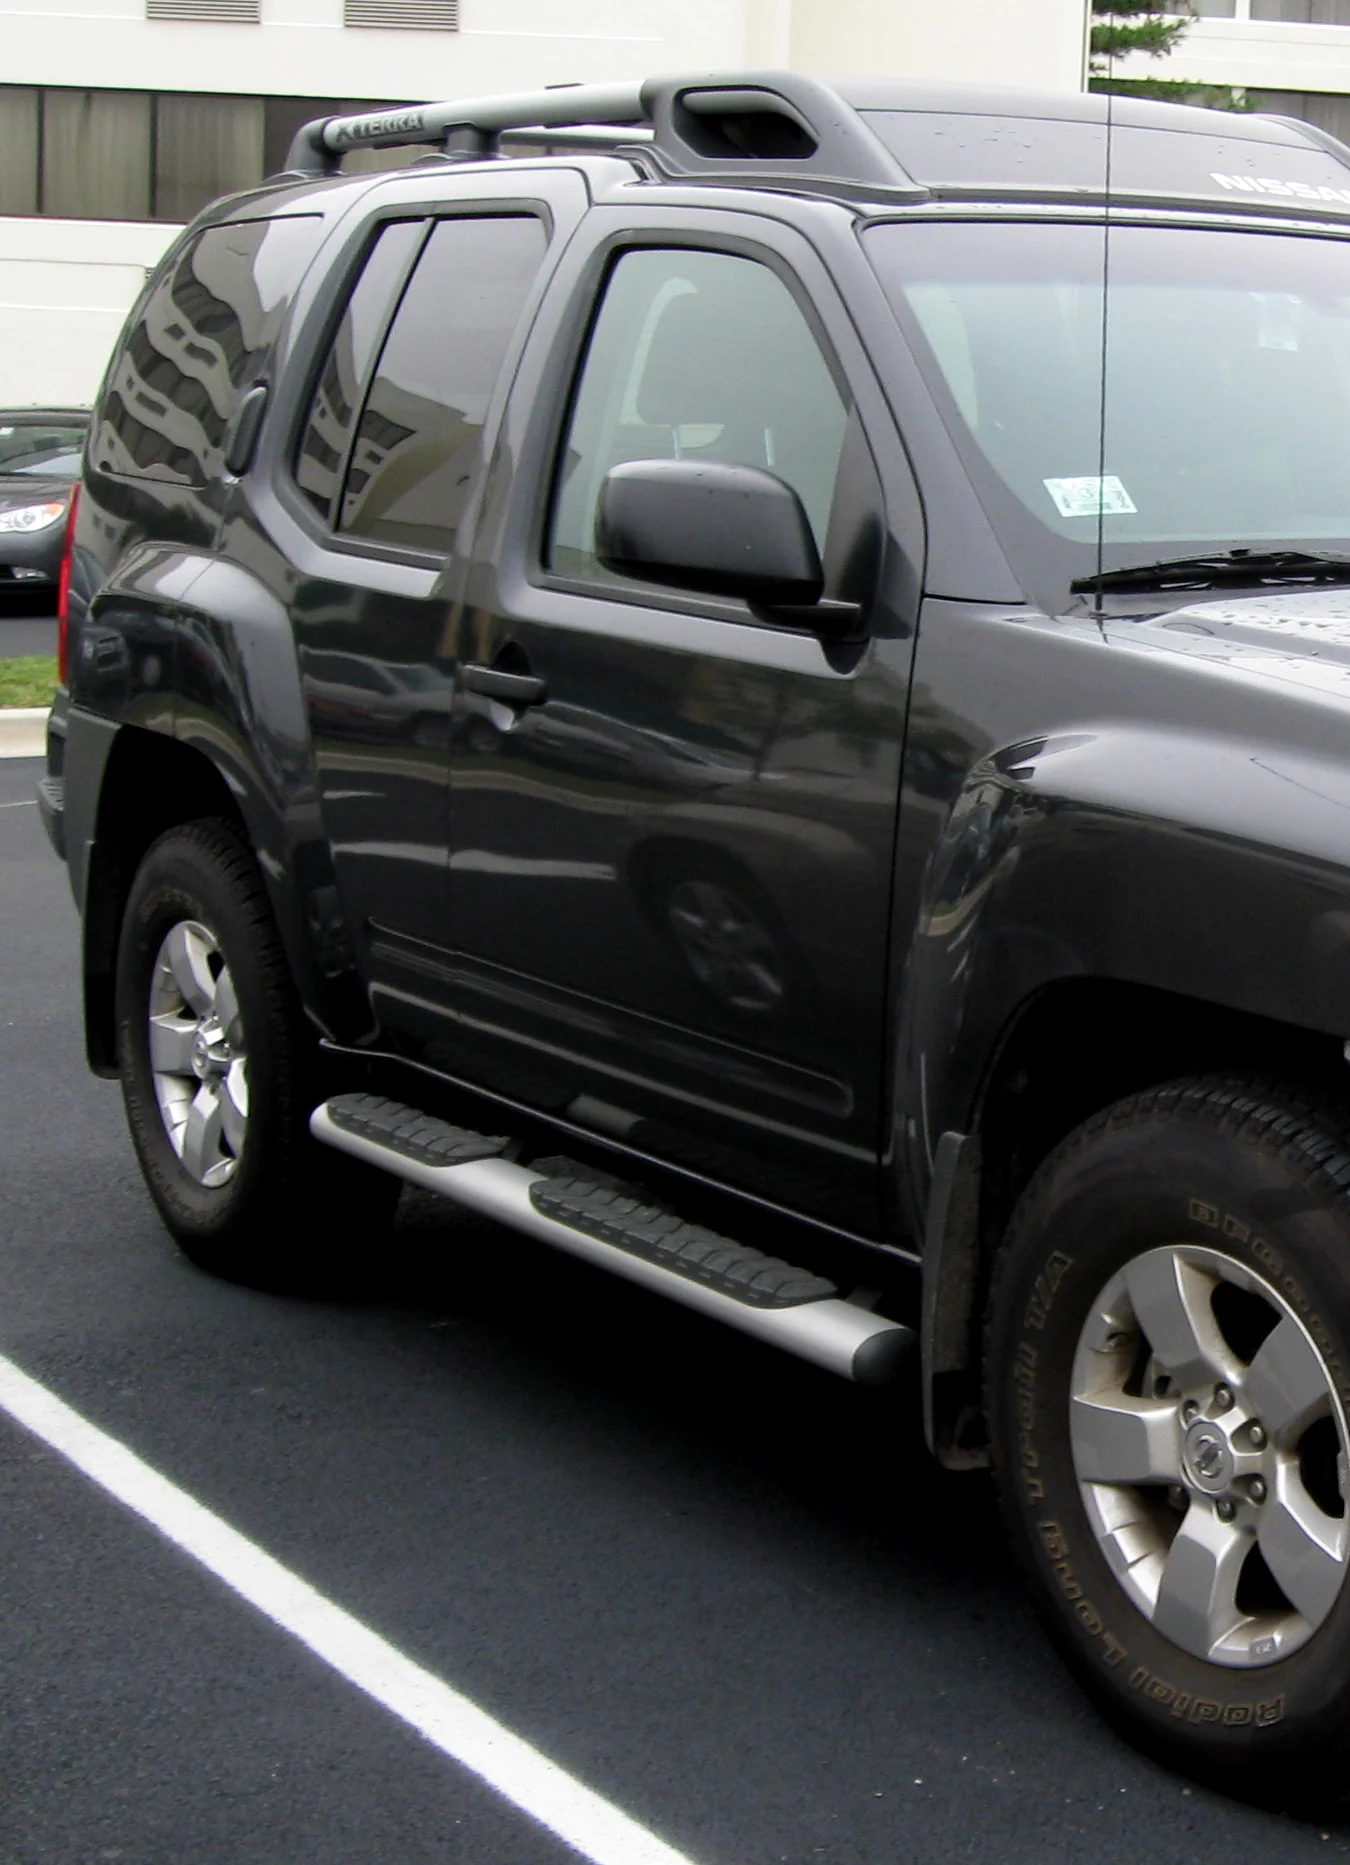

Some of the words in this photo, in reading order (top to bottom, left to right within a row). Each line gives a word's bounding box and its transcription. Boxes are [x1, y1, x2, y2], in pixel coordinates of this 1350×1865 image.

[336, 114, 424, 142] XTERRA
[1039, 1520, 1128, 1666] Long
[1128, 1665, 1286, 1728] Radial
